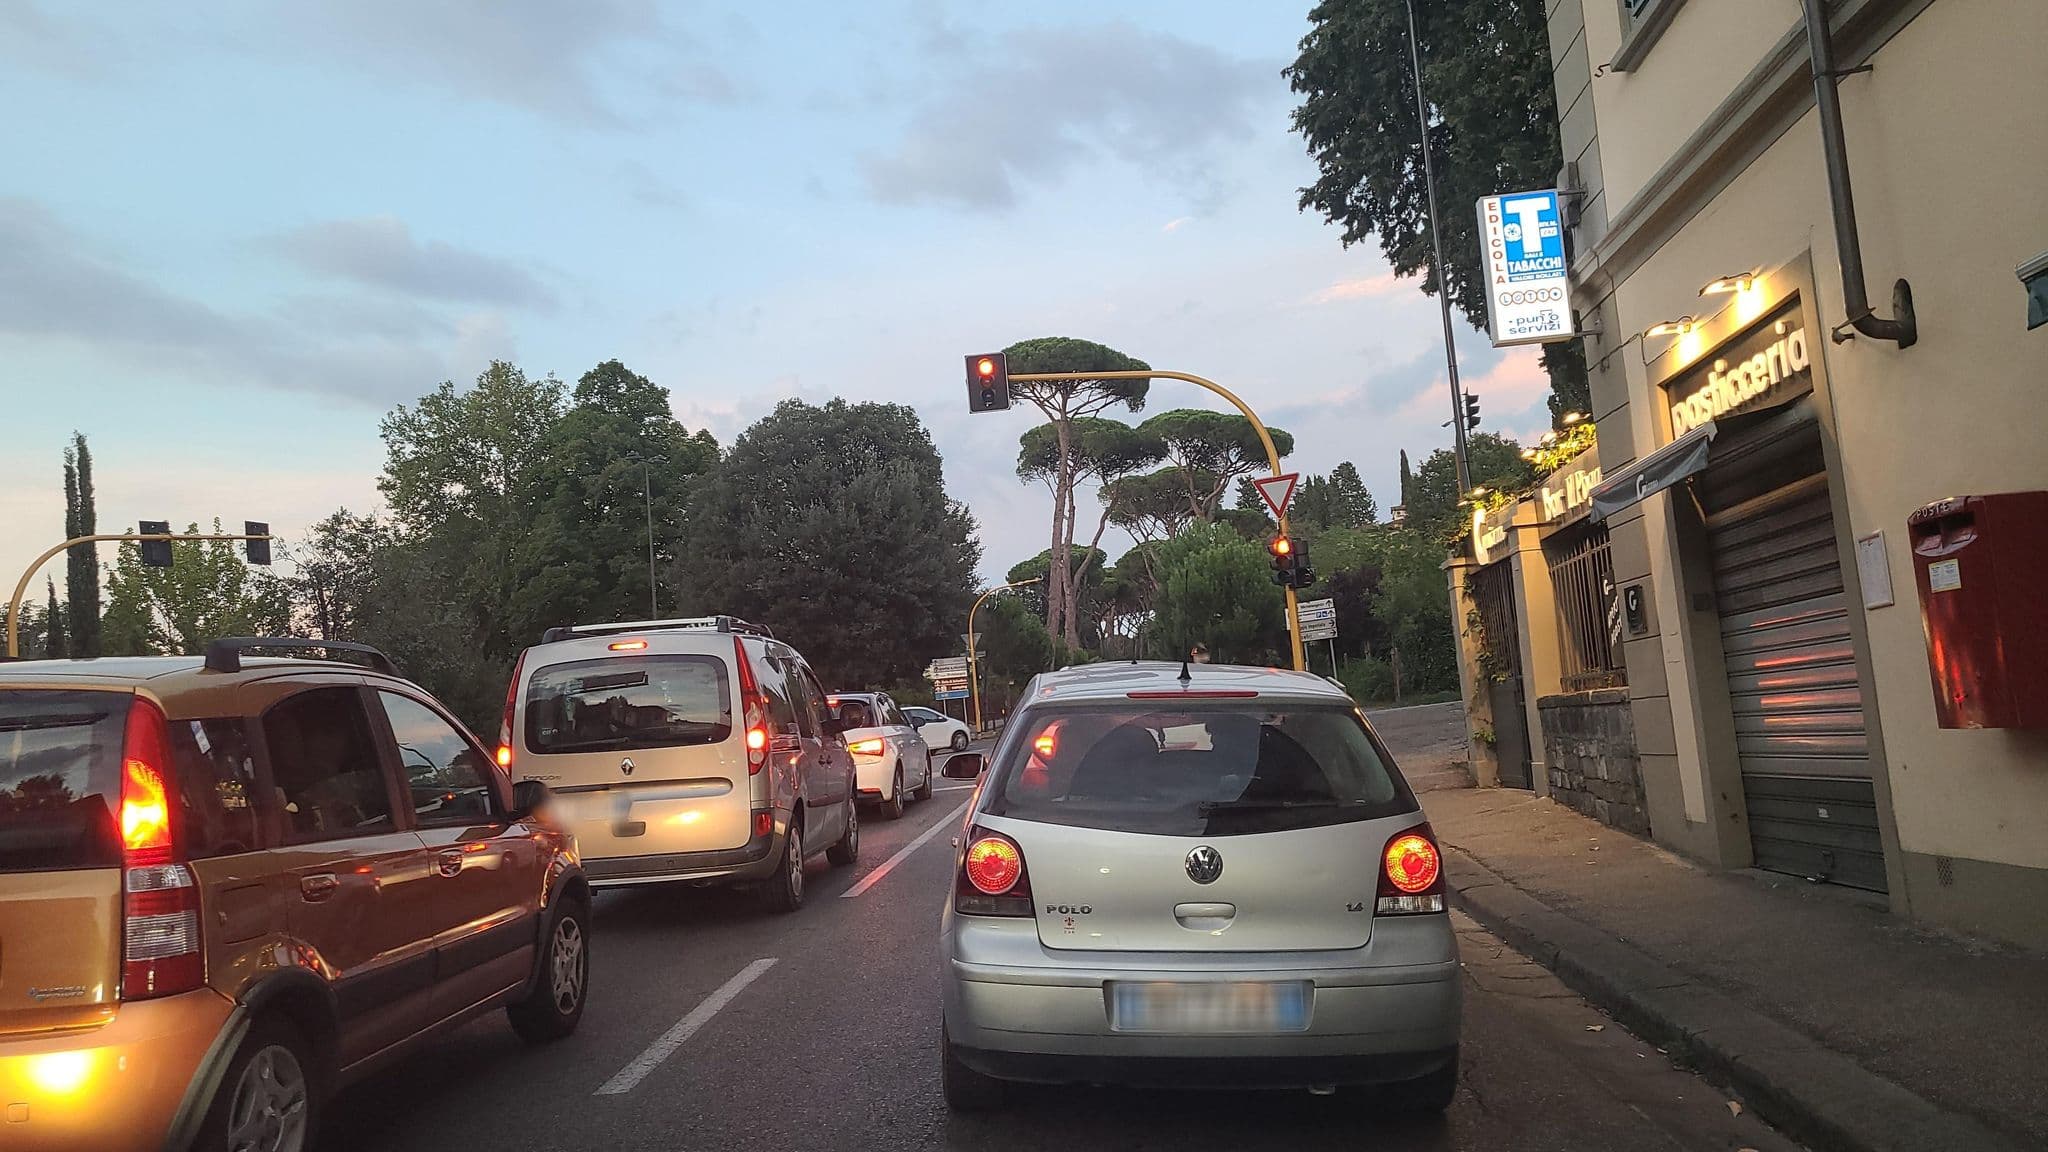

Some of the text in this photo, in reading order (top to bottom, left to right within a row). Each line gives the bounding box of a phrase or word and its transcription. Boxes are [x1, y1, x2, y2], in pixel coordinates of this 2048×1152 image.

[1505, 197, 1551, 253] T
[1488, 202, 1506, 284] EDICOLA
[1508, 256, 1562, 273] TABACCHI
[1509, 321, 1561, 335] servizi
[1671, 319, 1809, 436] pasticceria
[1916, 502, 1951, 519] POSTE
[1046, 905, 1093, 914] POLO
